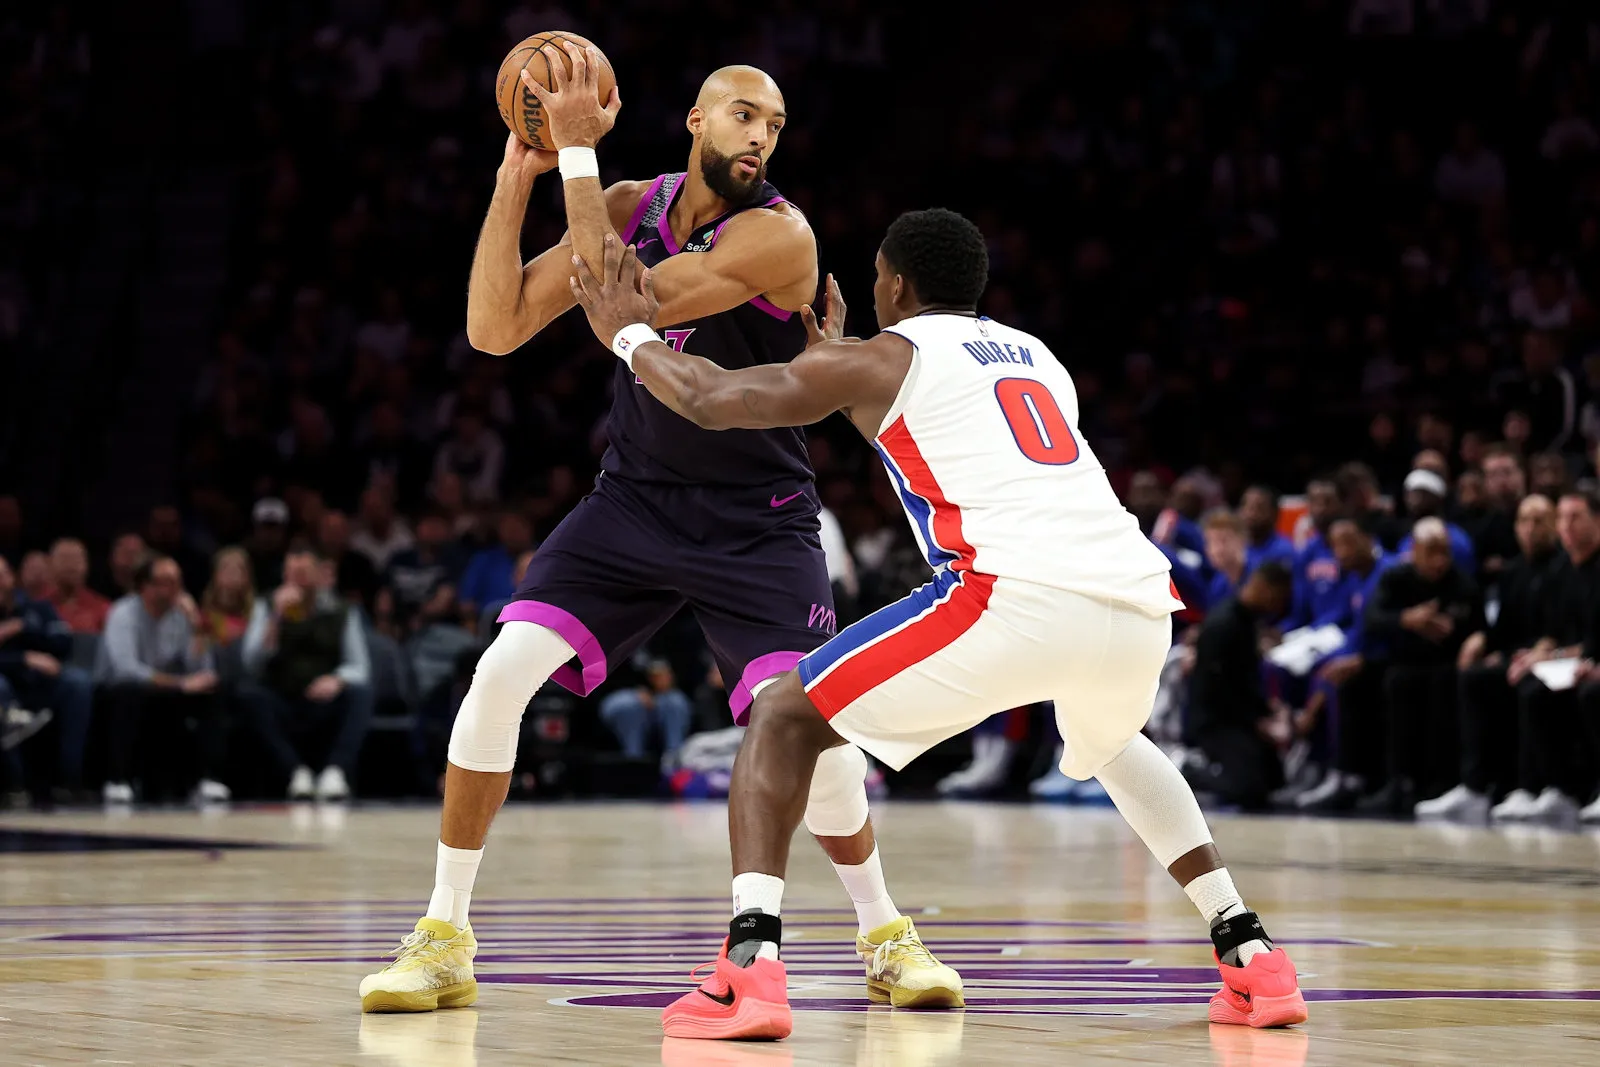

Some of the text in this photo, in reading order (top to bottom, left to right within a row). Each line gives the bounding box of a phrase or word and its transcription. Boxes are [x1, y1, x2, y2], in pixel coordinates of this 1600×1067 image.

[522, 83, 546, 148] Wilson
[962, 340, 1034, 368] DUREN
[994, 377, 1080, 466] 0
